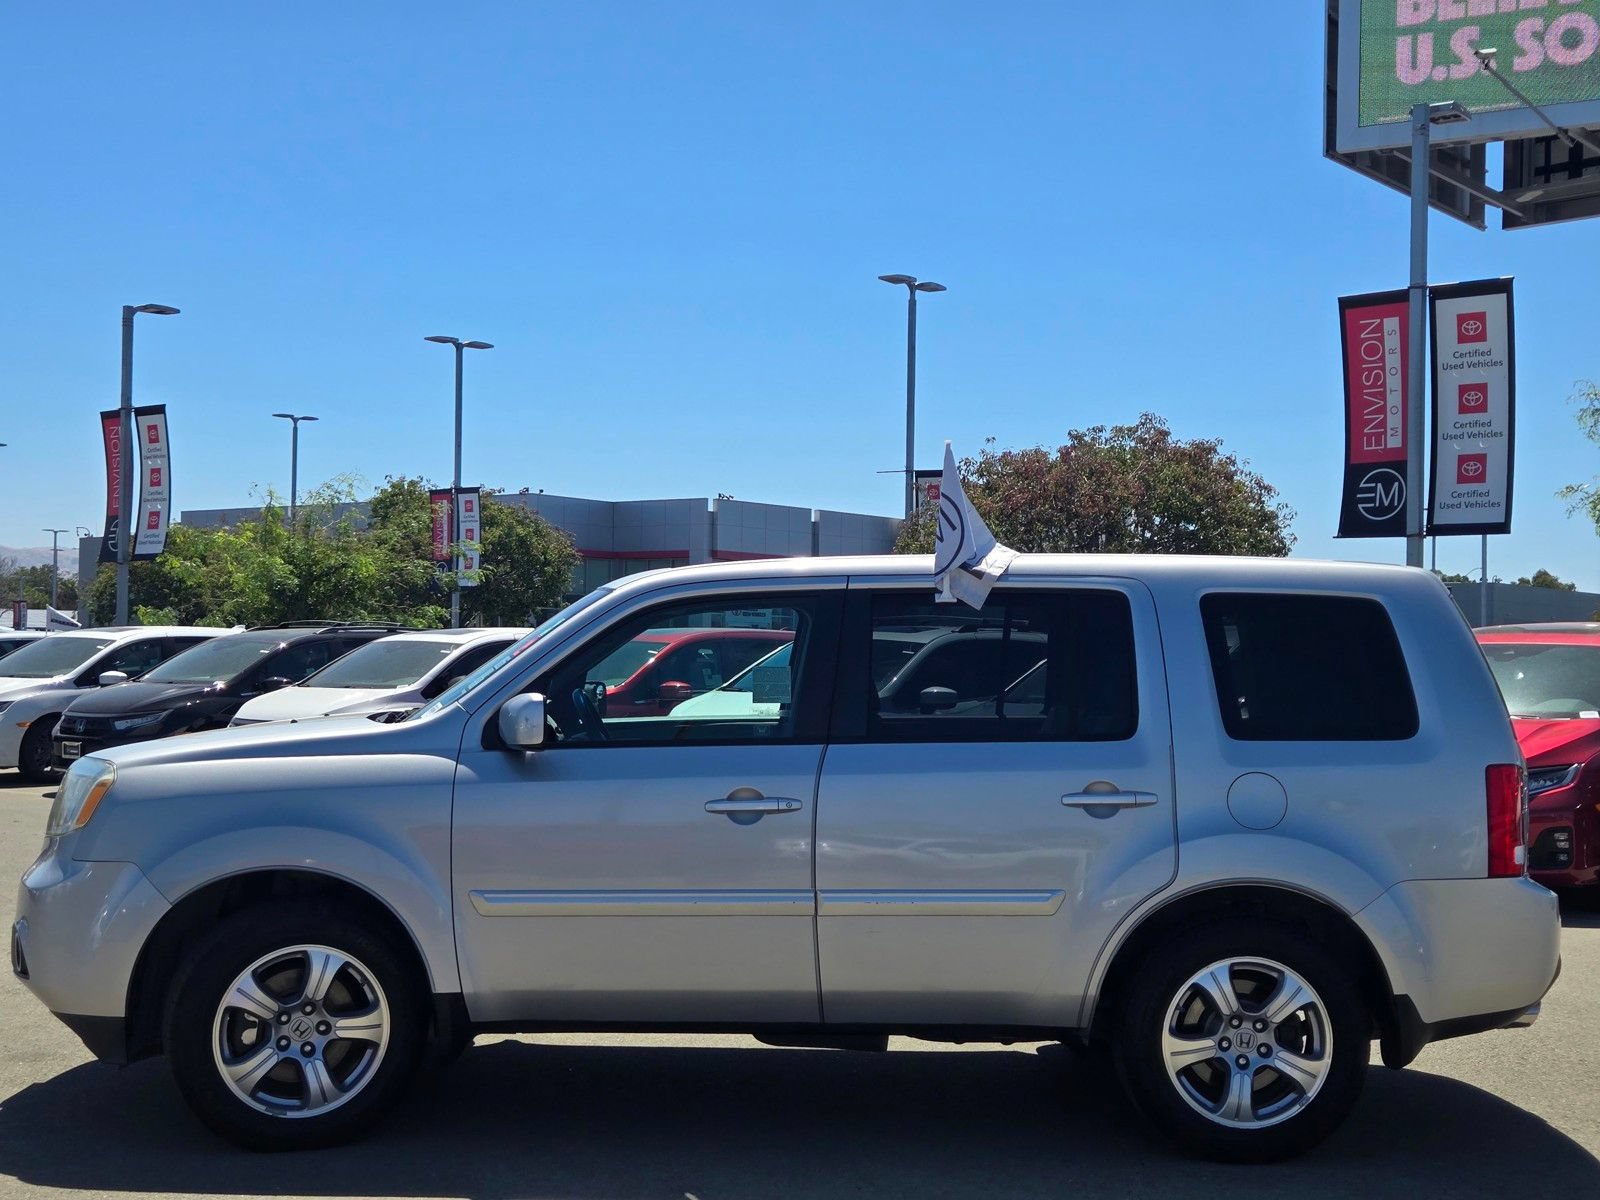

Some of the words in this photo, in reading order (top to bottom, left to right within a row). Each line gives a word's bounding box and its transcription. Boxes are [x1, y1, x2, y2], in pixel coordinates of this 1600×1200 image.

[1452, 348, 1492, 359] Certified
[1442, 361, 1465, 371] Used
[1466, 359, 1504, 369] Vehicles
[1360, 319, 1385, 451] ENVISION
[1387, 328, 1400, 438] MOTORS
[1453, 419, 1492, 429] Certified
[1442, 432, 1465, 441] Used
[1466, 429, 1504, 439] Vehicles
[1451, 489, 1490, 499] Certified
[1439, 501, 1462, 510] Used
[1463, 499, 1501, 509] Vehicles
